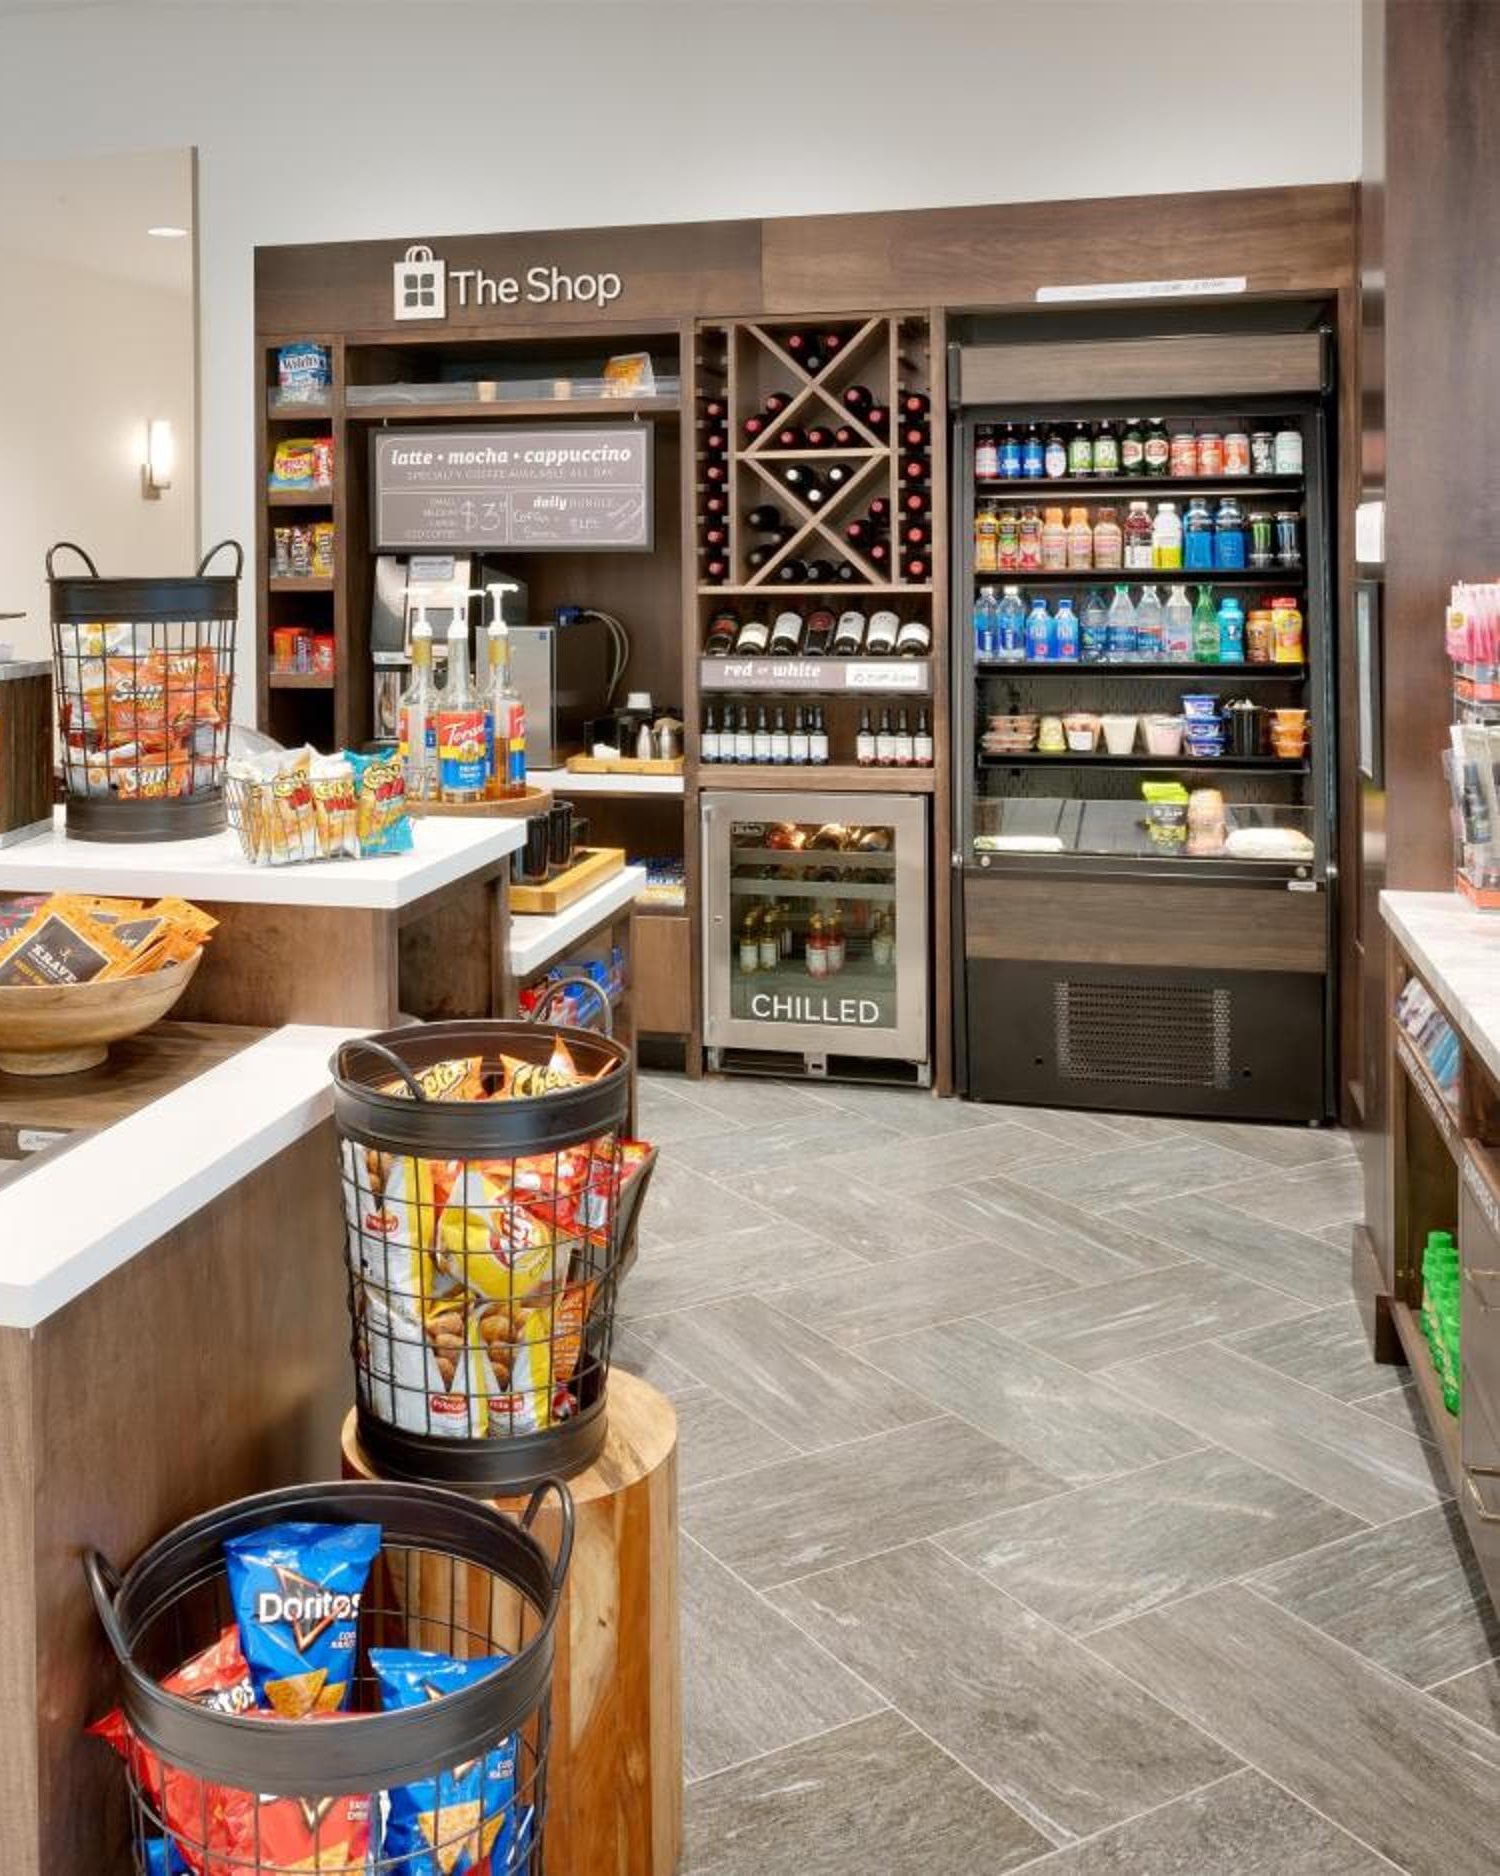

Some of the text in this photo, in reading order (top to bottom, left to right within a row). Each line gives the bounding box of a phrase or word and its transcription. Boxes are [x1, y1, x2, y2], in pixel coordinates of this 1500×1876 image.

[449, 267, 621, 307] The Shop
[391, 444, 632, 467] latte mocha cappuccino
[533, 495, 567, 510] daily
[723, 661, 752, 677] red
[773, 661, 821, 677] white
[751, 993, 879, 1023] CHILLED
[259, 1592, 361, 1623] Doritos
